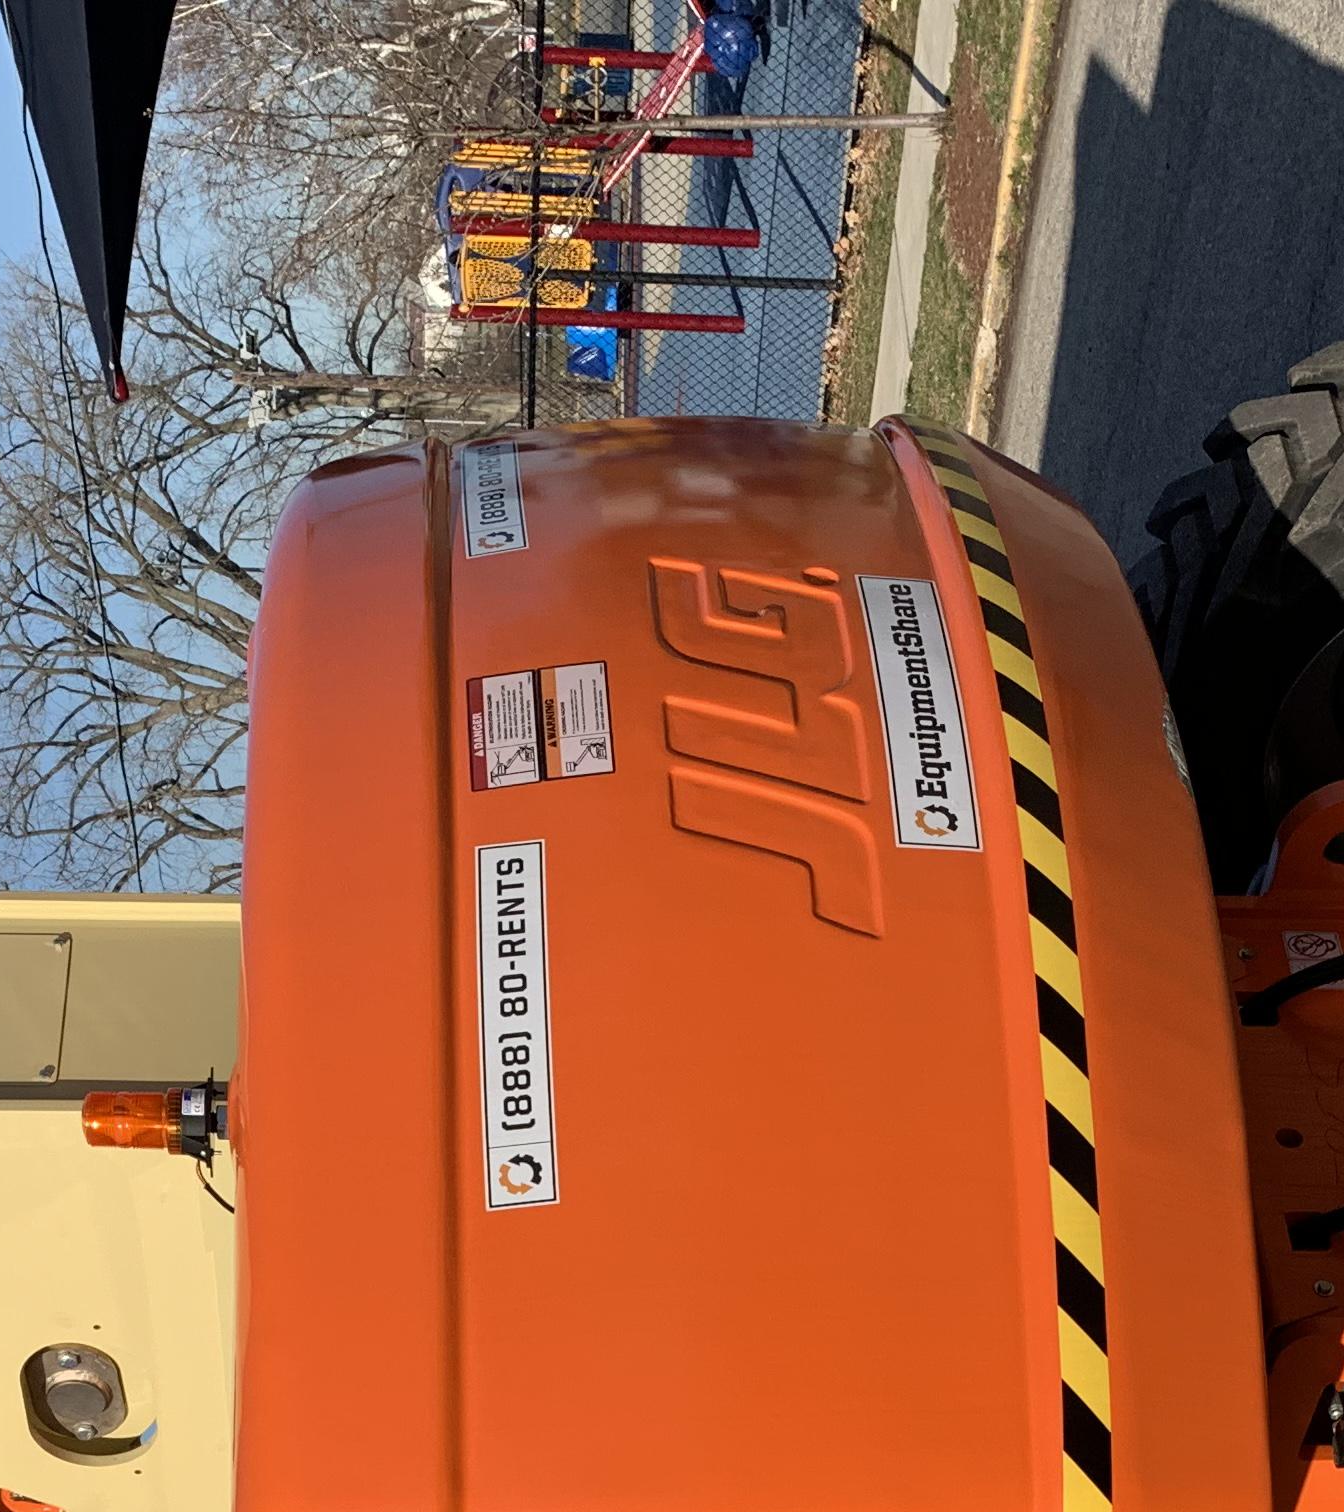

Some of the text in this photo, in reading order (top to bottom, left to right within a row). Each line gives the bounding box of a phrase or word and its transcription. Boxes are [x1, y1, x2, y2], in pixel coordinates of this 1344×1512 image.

[477, 488, 508, 525] (888)
[888, 584, 953, 799] EquipmentShare
[472, 712, 484, 749] DANGER
[545, 699, 557, 740] WARNING
[496, 857, 535, 1131] (888) 80-RENTS
